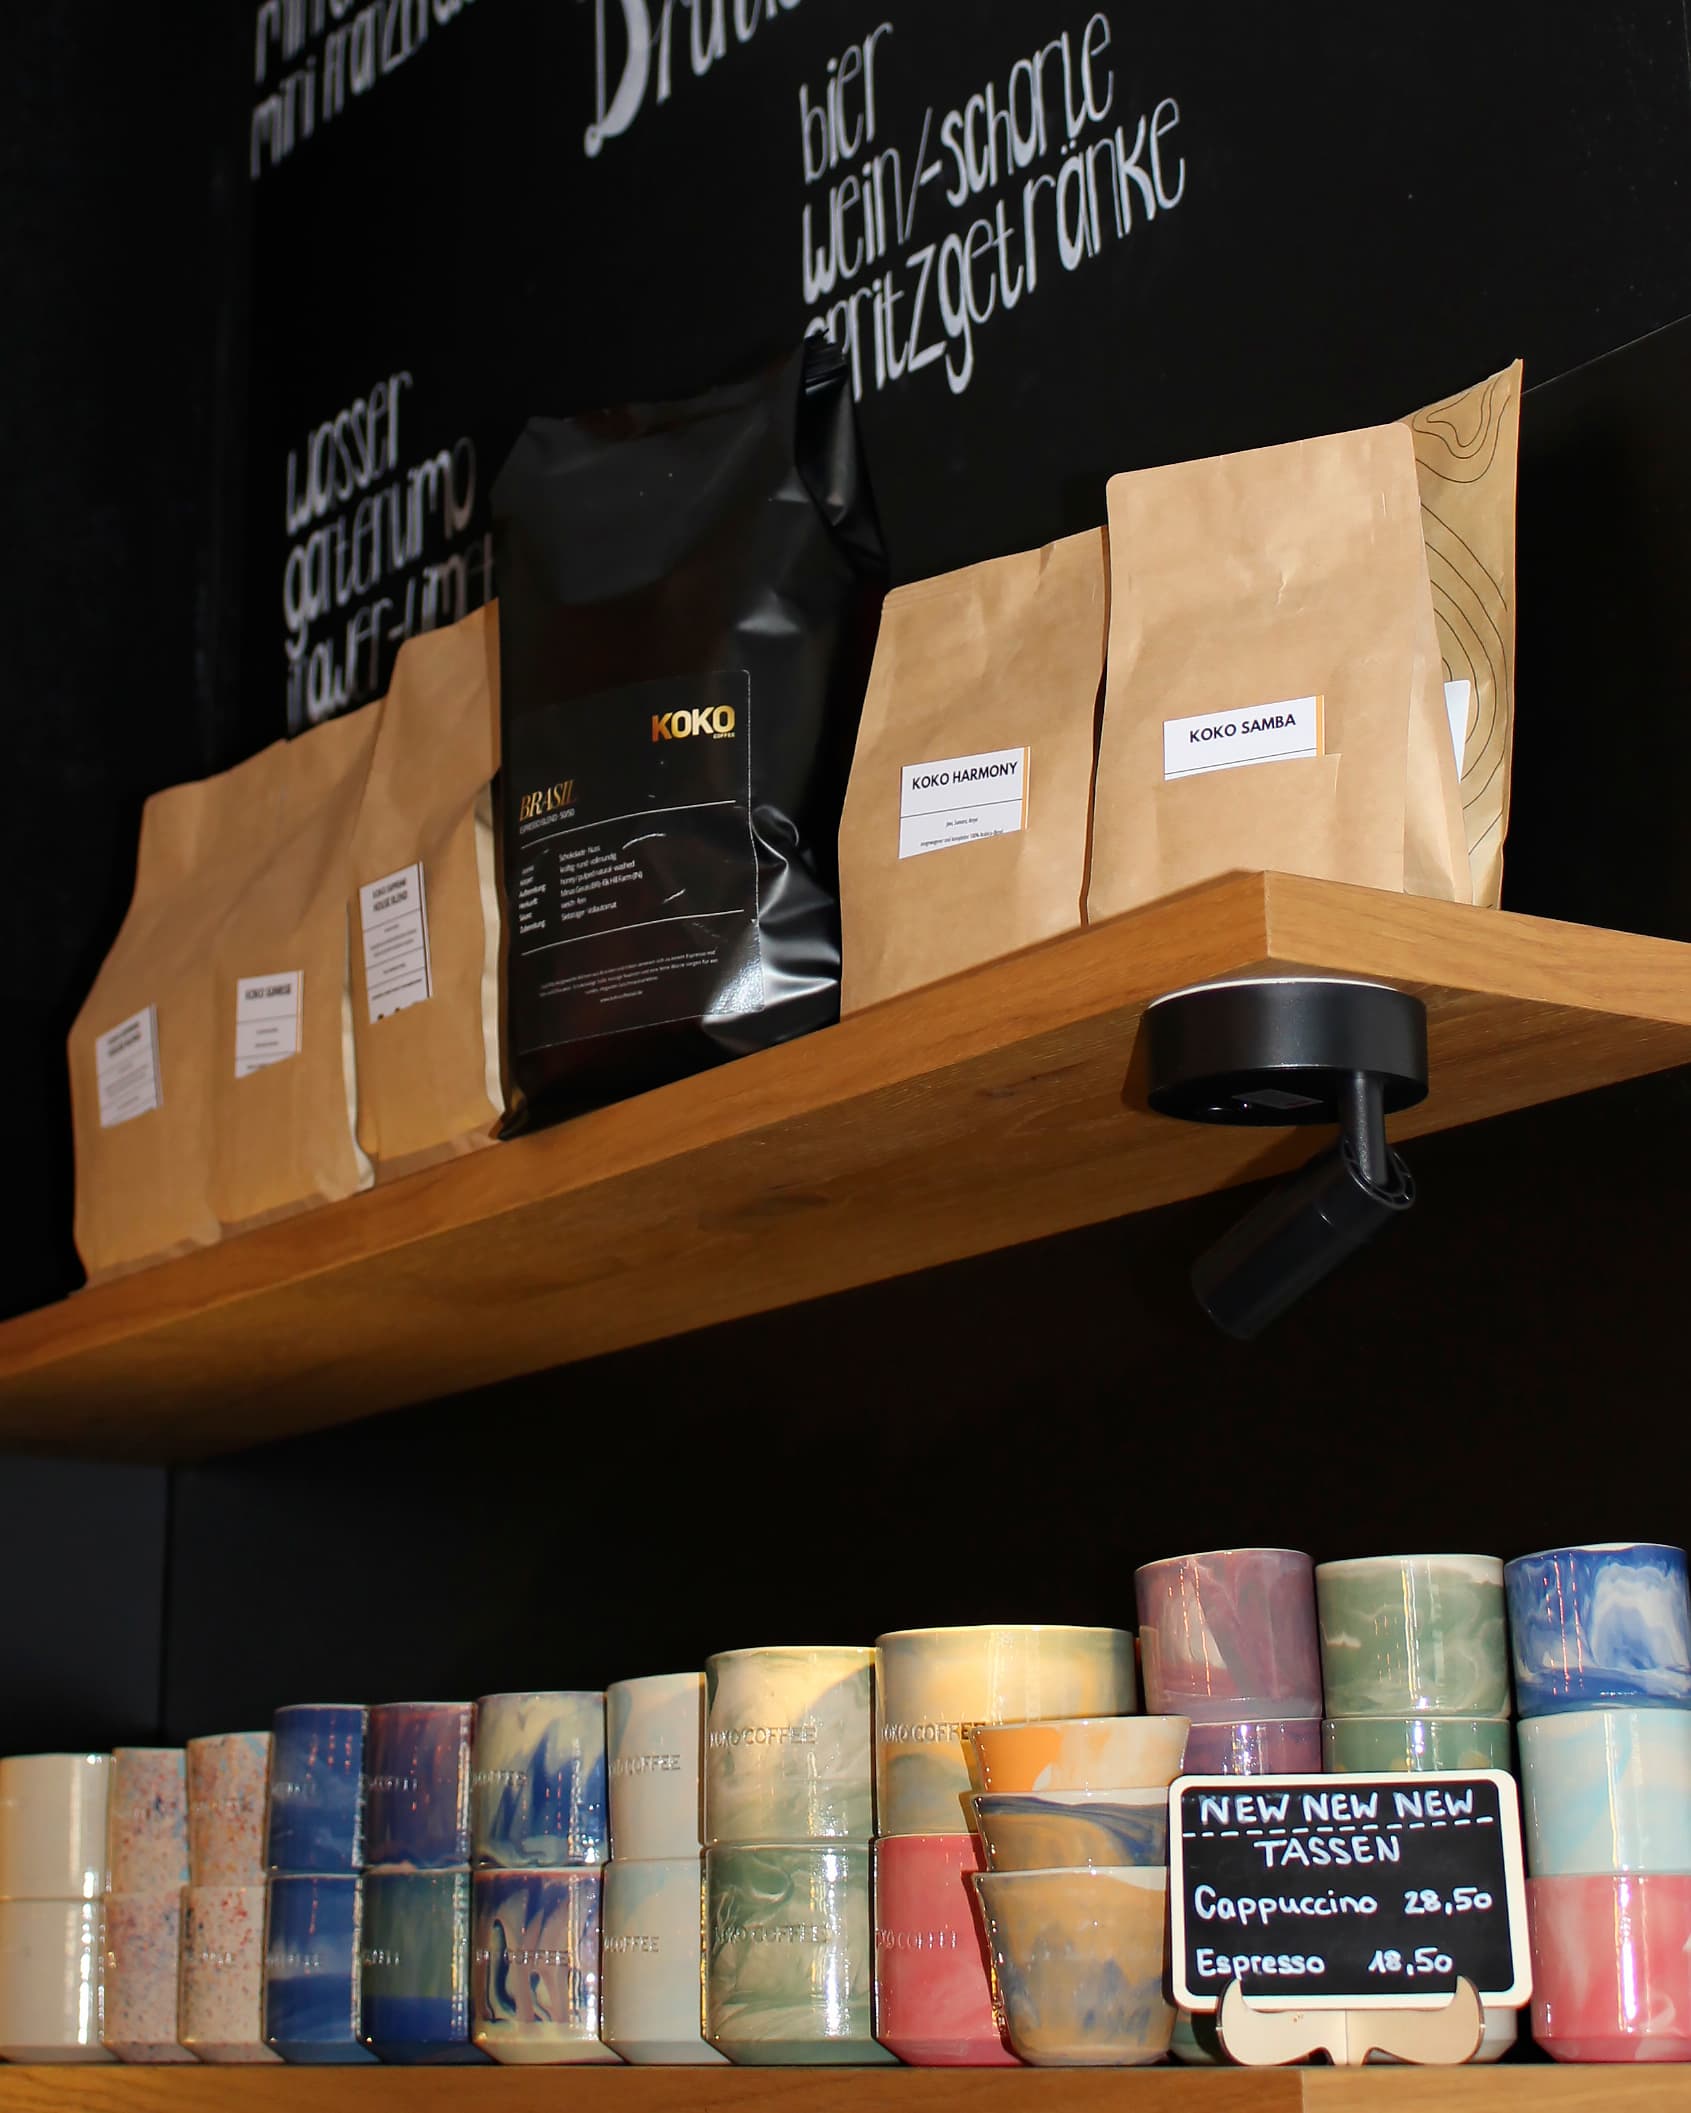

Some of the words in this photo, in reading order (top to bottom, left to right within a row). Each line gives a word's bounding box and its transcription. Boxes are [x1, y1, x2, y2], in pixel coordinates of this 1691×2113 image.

[799, 22, 893, 185] bier
[803, 13, 1114, 304] wein/-schorle
[804, 97, 1186, 403] pritzgetränke
[287, 371, 413, 536] wasser
[652, 705, 735, 742] KOKO
[1189, 724, 1237, 743] KOKO
[1241, 713, 1297, 734] SAMBA
[911, 773, 950, 790] KOKO
[953, 761, 1018, 784] HARMONY
[520, 780, 575, 822] BRASIL
[742, 1726, 817, 1746] COFFEE
[1201, 1793, 1289, 1825] NEW
[1303, 1791, 1378, 1823] NEW
[1394, 1789, 1473, 1818] NEW
[1254, 1835, 1400, 1867] TASSEN
[1194, 1885, 1377, 1925] Cappuccino
[1404, 1886, 1493, 1915] 28,50
[1196, 1948, 1325, 1980] Espresso
[1368, 1947, 1453, 1977] 18,50
